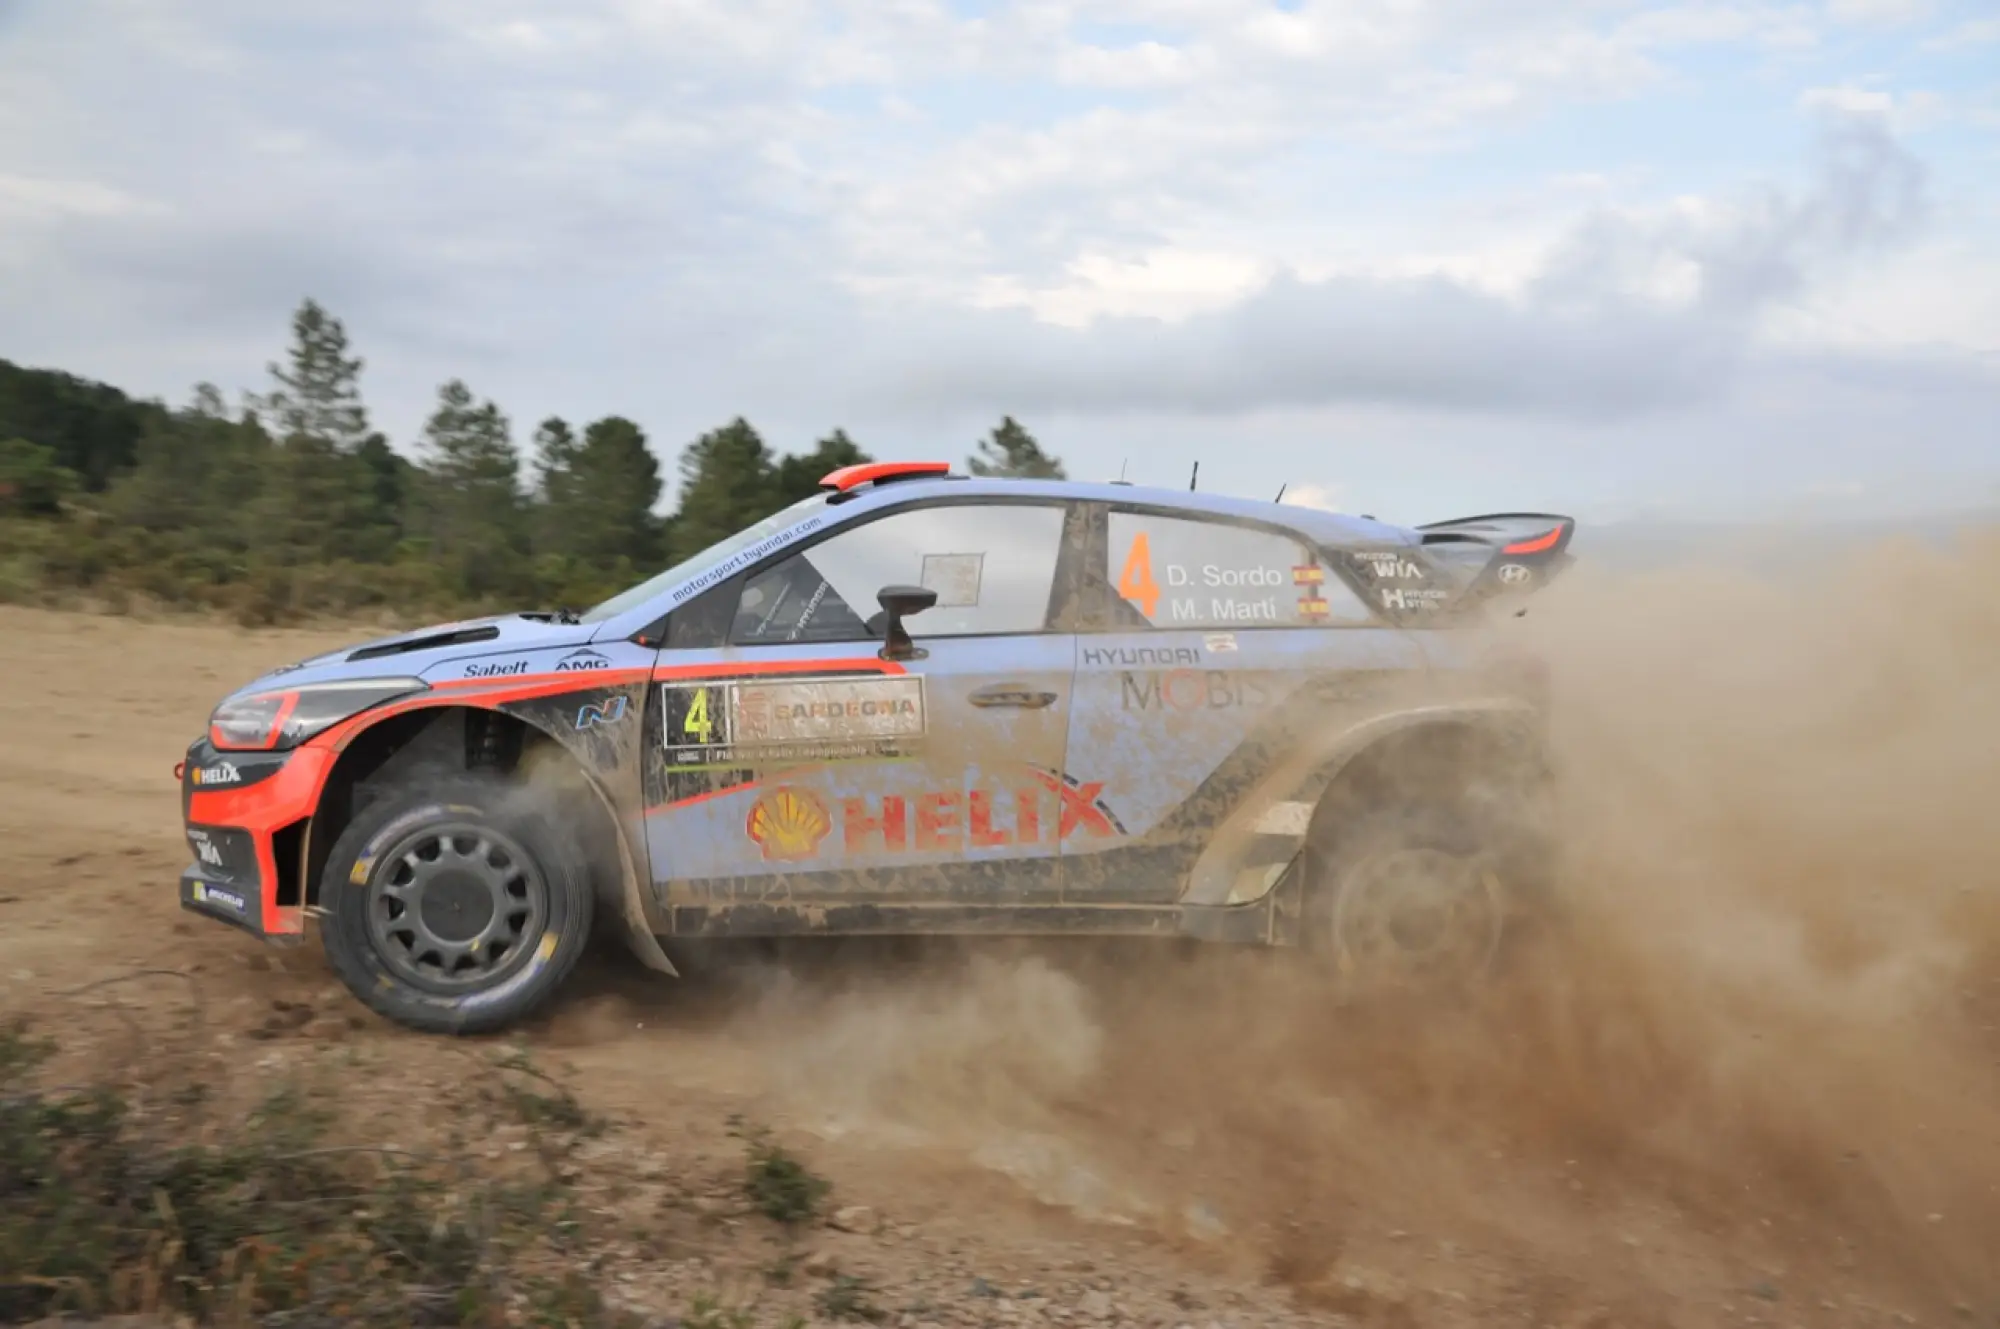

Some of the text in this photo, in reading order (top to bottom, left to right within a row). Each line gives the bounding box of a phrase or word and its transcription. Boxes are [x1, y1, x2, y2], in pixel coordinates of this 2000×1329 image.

[672, 517, 822, 601] motorsport.hyundai.com
[1119, 531, 1160, 619] 4
[1167, 564, 1282, 587] D. Sordo
[1171, 595, 1276, 621] M. Martí
[556, 660, 609, 671] AMG
[1083, 647, 1200, 665] HYUNDAI
[464, 660, 529, 678] Sabelt
[1120, 667, 1268, 714] MOBIS
[684, 687, 712, 743] 4
[773, 699, 915, 720] SARDEGNA
[200, 762, 241, 784] HELIX
[844, 764, 1128, 853] HELIX
